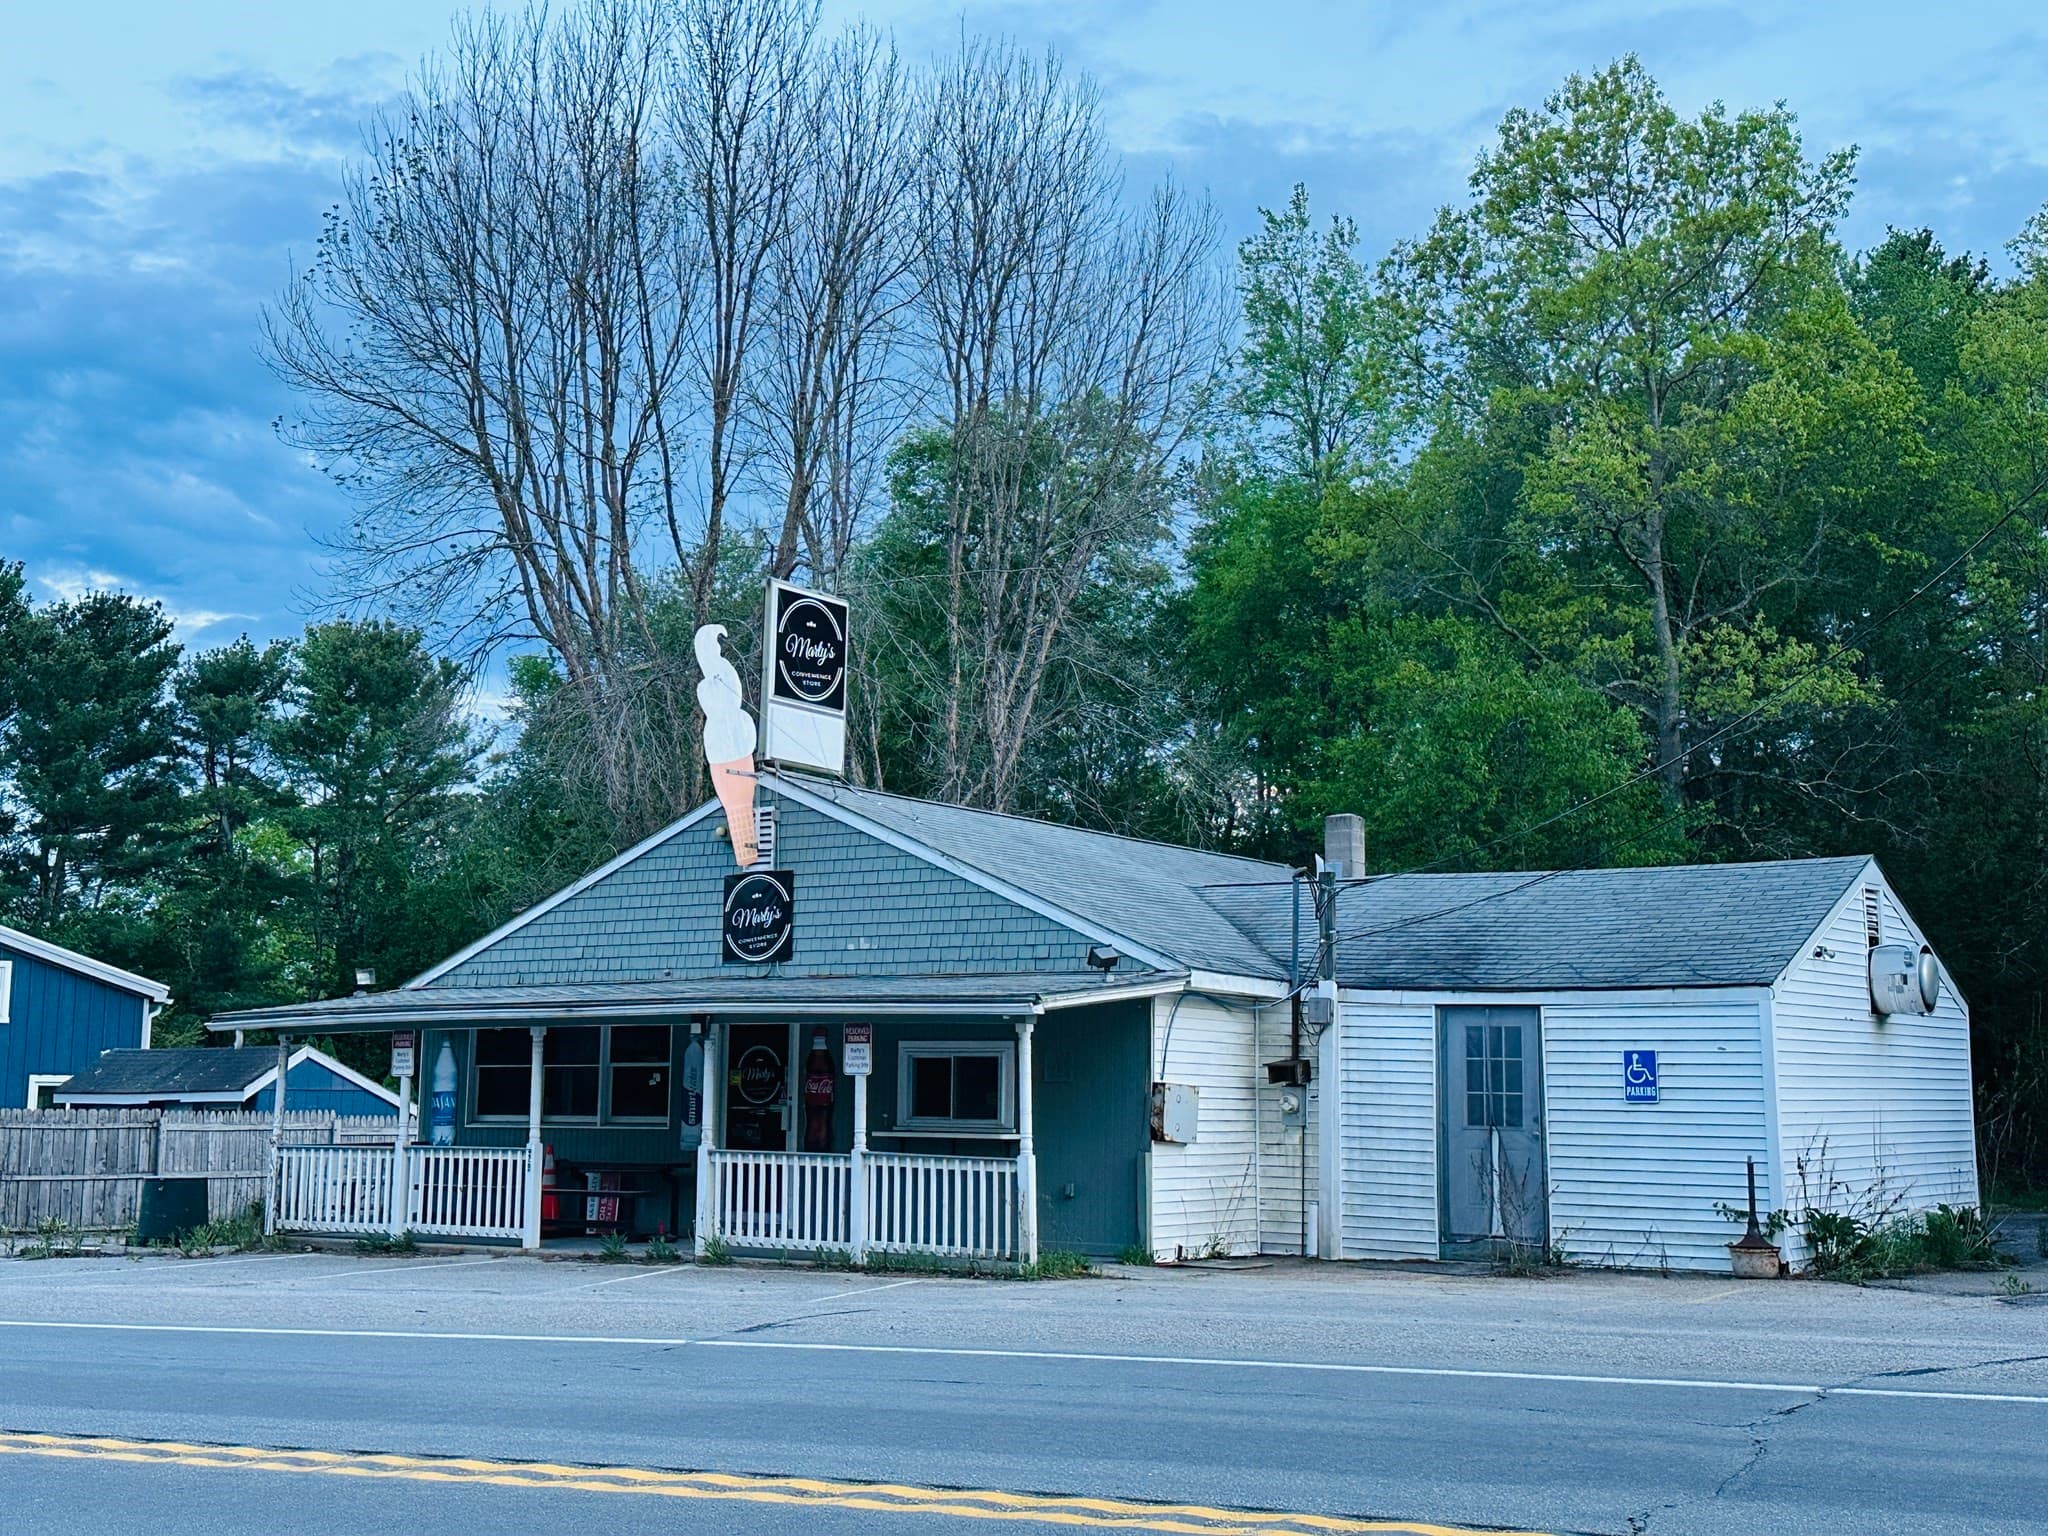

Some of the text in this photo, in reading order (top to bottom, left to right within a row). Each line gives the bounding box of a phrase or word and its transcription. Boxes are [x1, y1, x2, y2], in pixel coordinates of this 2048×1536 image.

[785, 633, 836, 666] Marty's
[791, 670, 832, 681] CONVENIENCE
[732, 905, 782, 929] Marty's
[1626, 1086, 1657, 1097] PARKING
